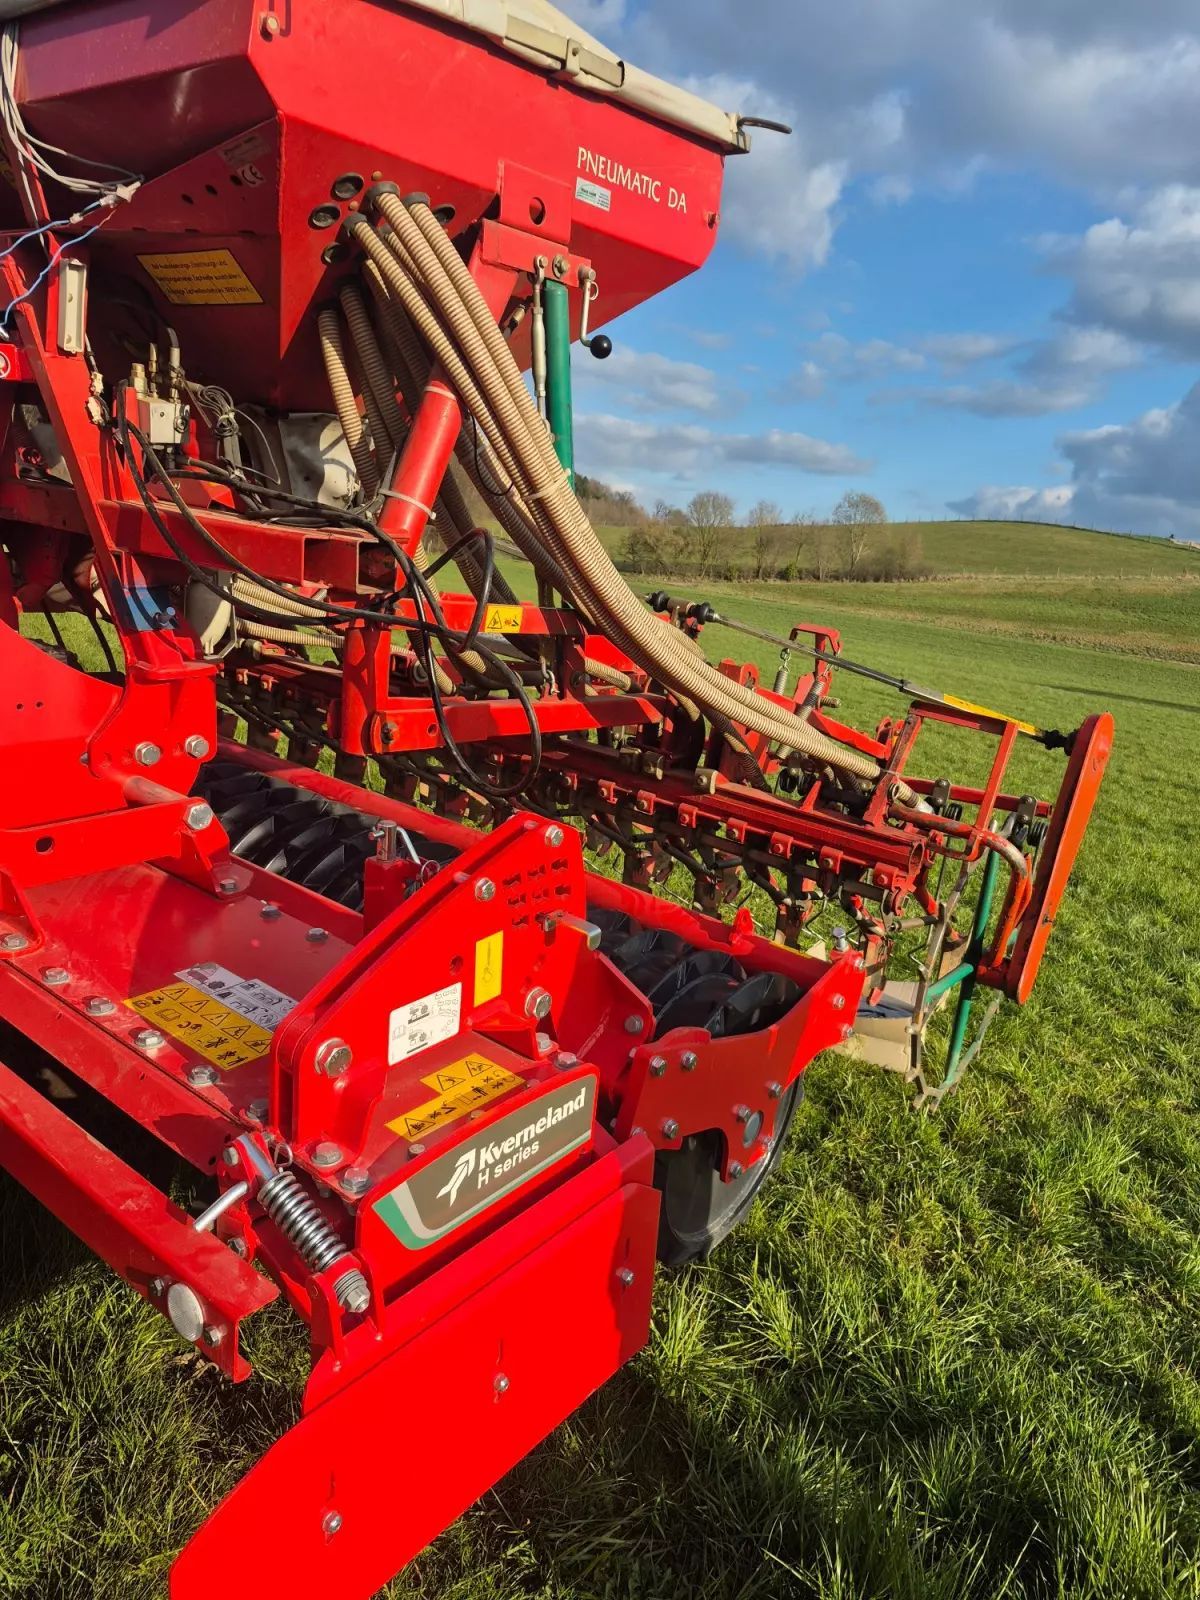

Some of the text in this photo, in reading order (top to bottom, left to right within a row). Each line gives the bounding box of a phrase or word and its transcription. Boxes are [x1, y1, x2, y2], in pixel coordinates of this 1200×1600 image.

[577, 146, 661, 203] PNEUMATIC
[668, 187, 687, 214] DA
[478, 1086, 587, 1171] Kverneland
[477, 1140, 540, 1190] H series
